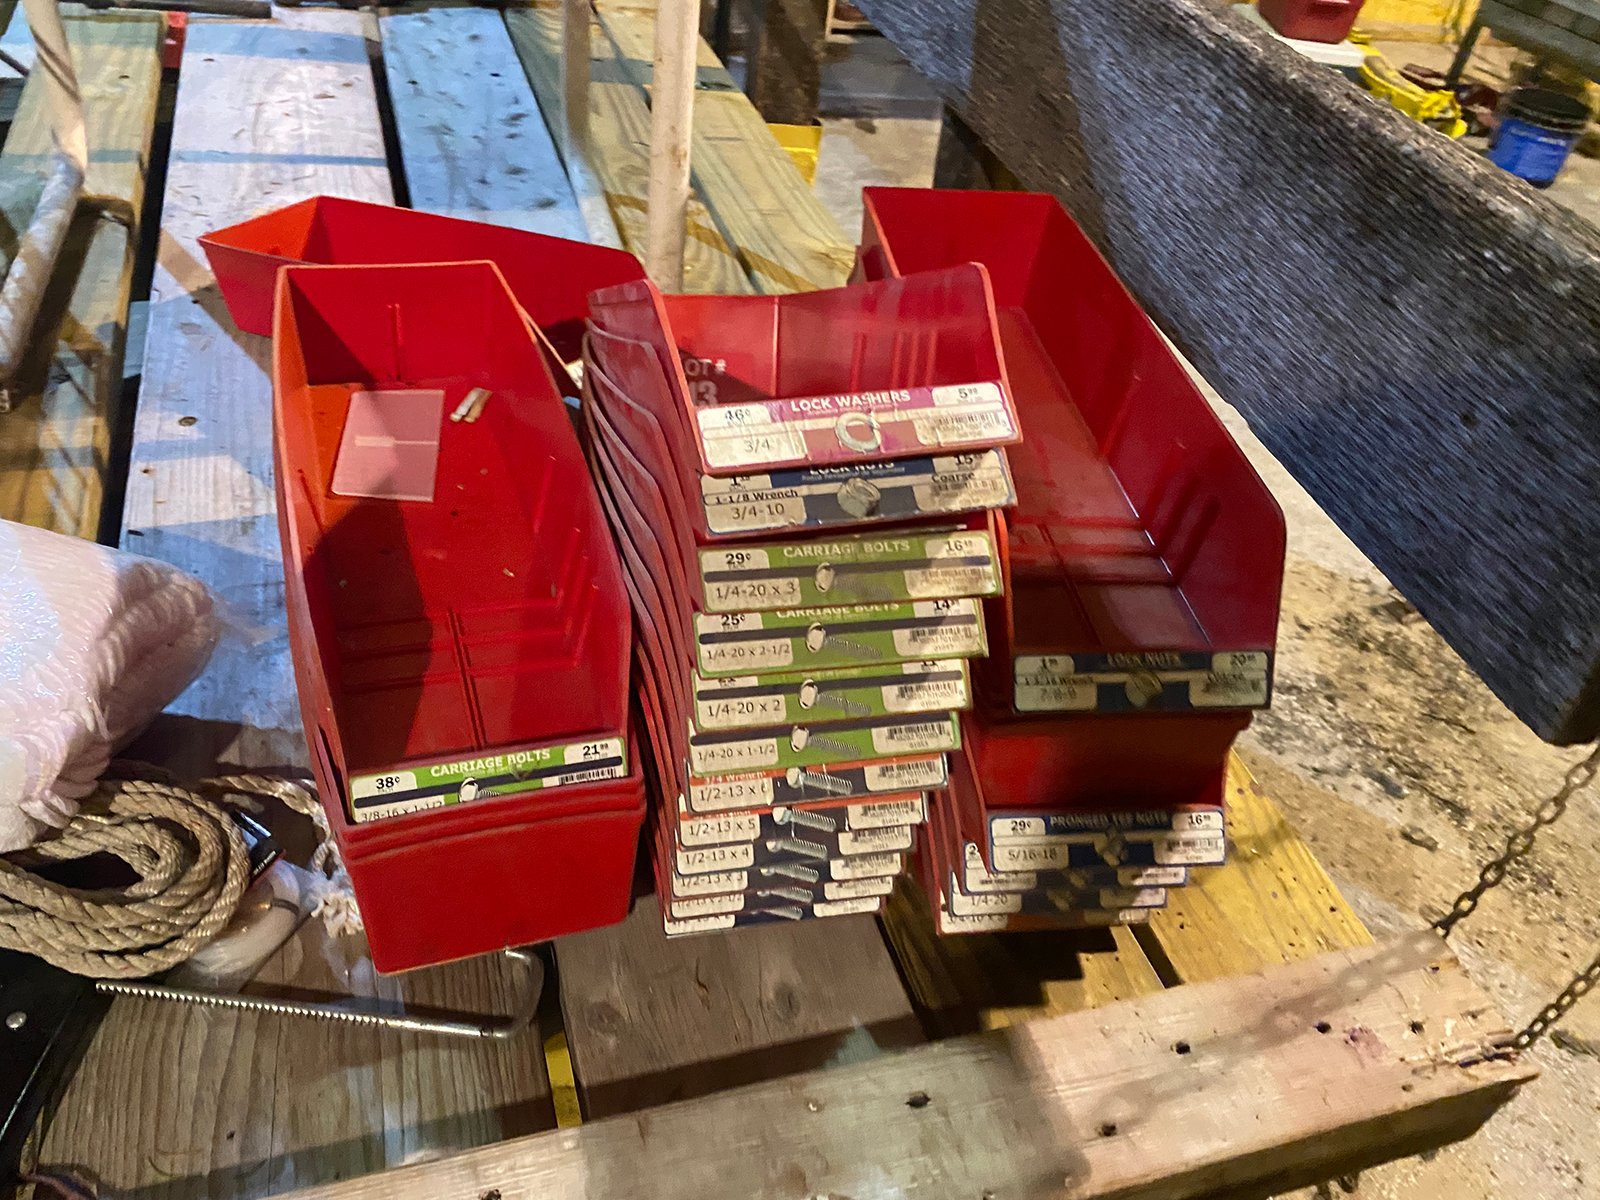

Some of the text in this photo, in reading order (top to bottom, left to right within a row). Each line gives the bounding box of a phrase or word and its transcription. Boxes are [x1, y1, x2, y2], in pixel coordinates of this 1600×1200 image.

[684, 358, 713, 377] OT
[790, 397, 831, 413] LOCK
[836, 389, 911, 409] WASHERS
[744, 438, 770, 454] 3/4
[715, 488, 799, 505] 1-1/8 Wrench
[731, 503, 785, 521] 3/4-10
[863, 539, 911, 553] BOLTS
[725, 552, 752, 565] 29¢
[716, 582, 796, 600] 1/4-20 x 3
[721, 613, 746, 626] 25¢
[707, 648, 745, 660] 1/4-20
[759, 643, 791, 656] 2-1/2
[708, 699, 781, 718] 1/4-20 x 2
[698, 743, 775, 764] 1/4-20 x 1-1/2
[430, 757, 504, 777] CARRIAGE
[507, 749, 551, 769] BOLTS
[375, 776, 400, 790] 38¢
[700, 784, 744, 801] 1/2-13
[748, 785, 756, 795] x
[361, 808, 400, 823] 3/8-16
[689, 818, 756, 836] 1/2-13 x 5
[1010, 820, 1032, 832] 29¢
[685, 847, 749, 865] 1/2-13 x 4
[1008, 847, 1058, 861] 5/16-18
[681, 874, 721, 888] 1/2-13
